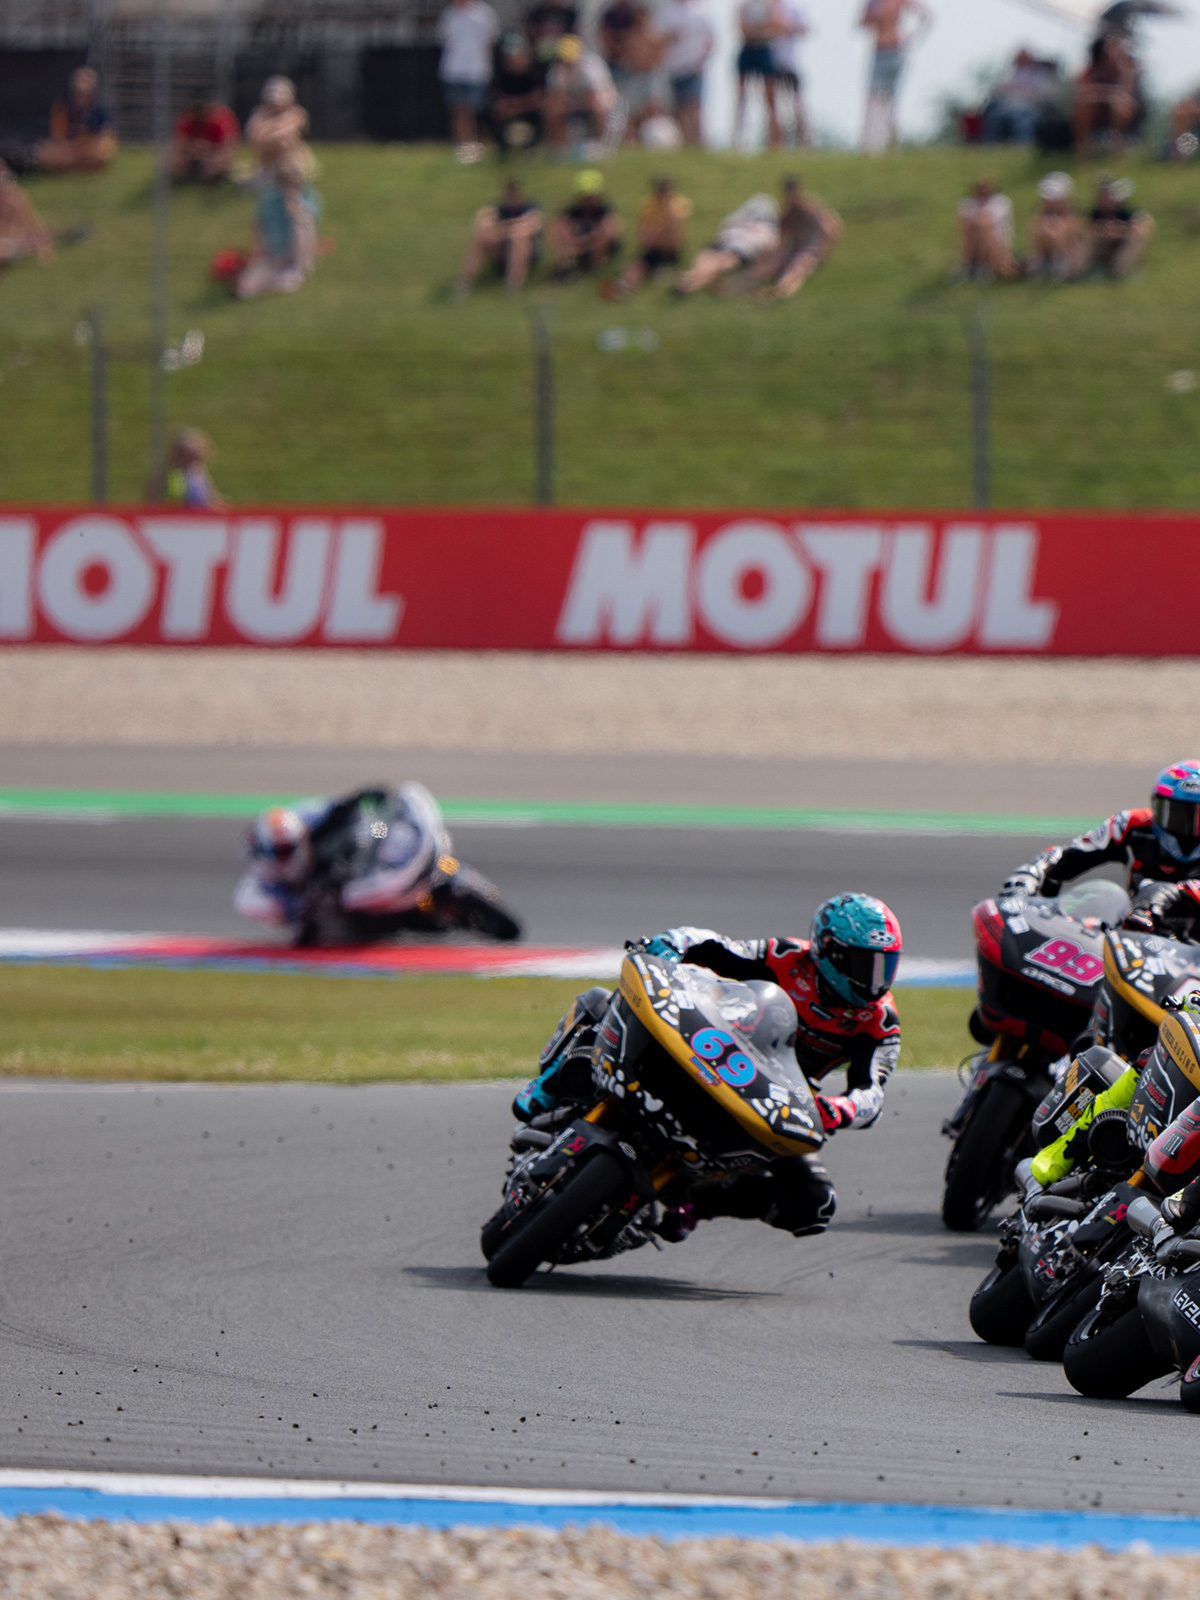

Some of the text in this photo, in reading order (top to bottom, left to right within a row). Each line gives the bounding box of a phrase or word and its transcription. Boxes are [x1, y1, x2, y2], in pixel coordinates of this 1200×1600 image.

[0, 514, 402, 641] OTUL
[555, 520, 1059, 649] MOTUL
[1023, 935, 1105, 986] 99
[691, 1027, 758, 1087] 69
